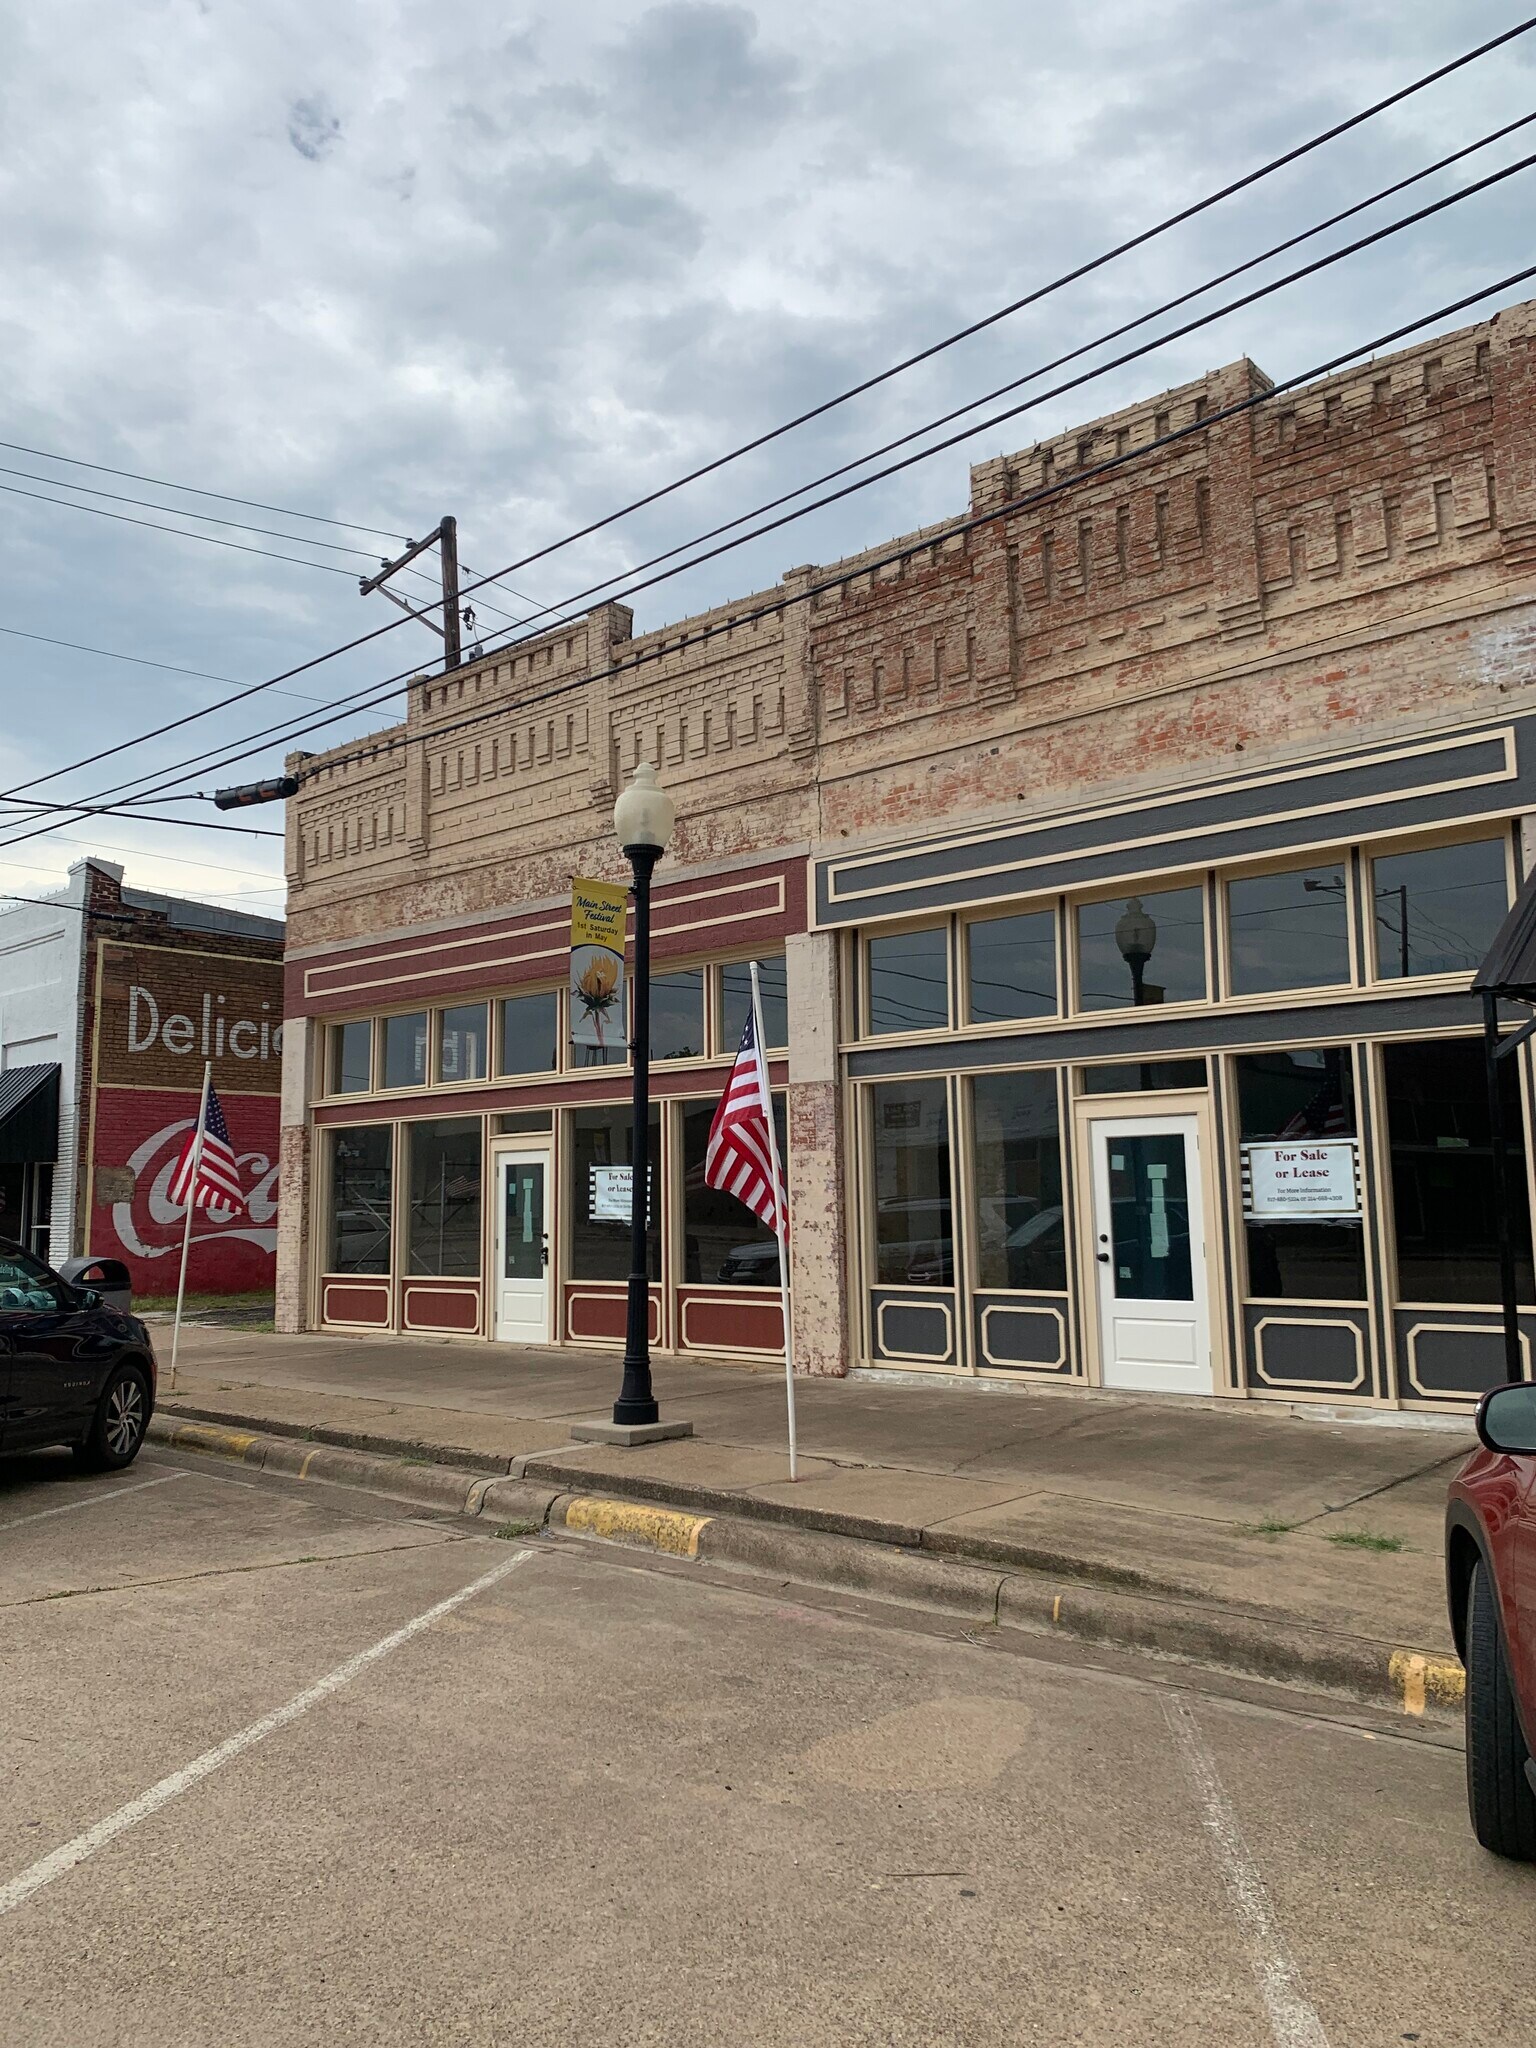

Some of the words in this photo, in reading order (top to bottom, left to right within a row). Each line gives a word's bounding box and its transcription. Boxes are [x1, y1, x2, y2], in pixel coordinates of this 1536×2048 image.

[576, 896, 598, 909] Main
[599, 900, 622, 913] Street
[584, 910, 614, 923] Festival
[590, 924, 618, 935] Saturday
[595, 933, 607, 942] May
[1275, 1151, 1297, 1162] For
[1300, 1149, 1328, 1161] Sale
[608, 1172, 618, 1180] For
[1275, 1171, 1289, 1179] or
[1293, 1167, 1329, 1178] Lease
